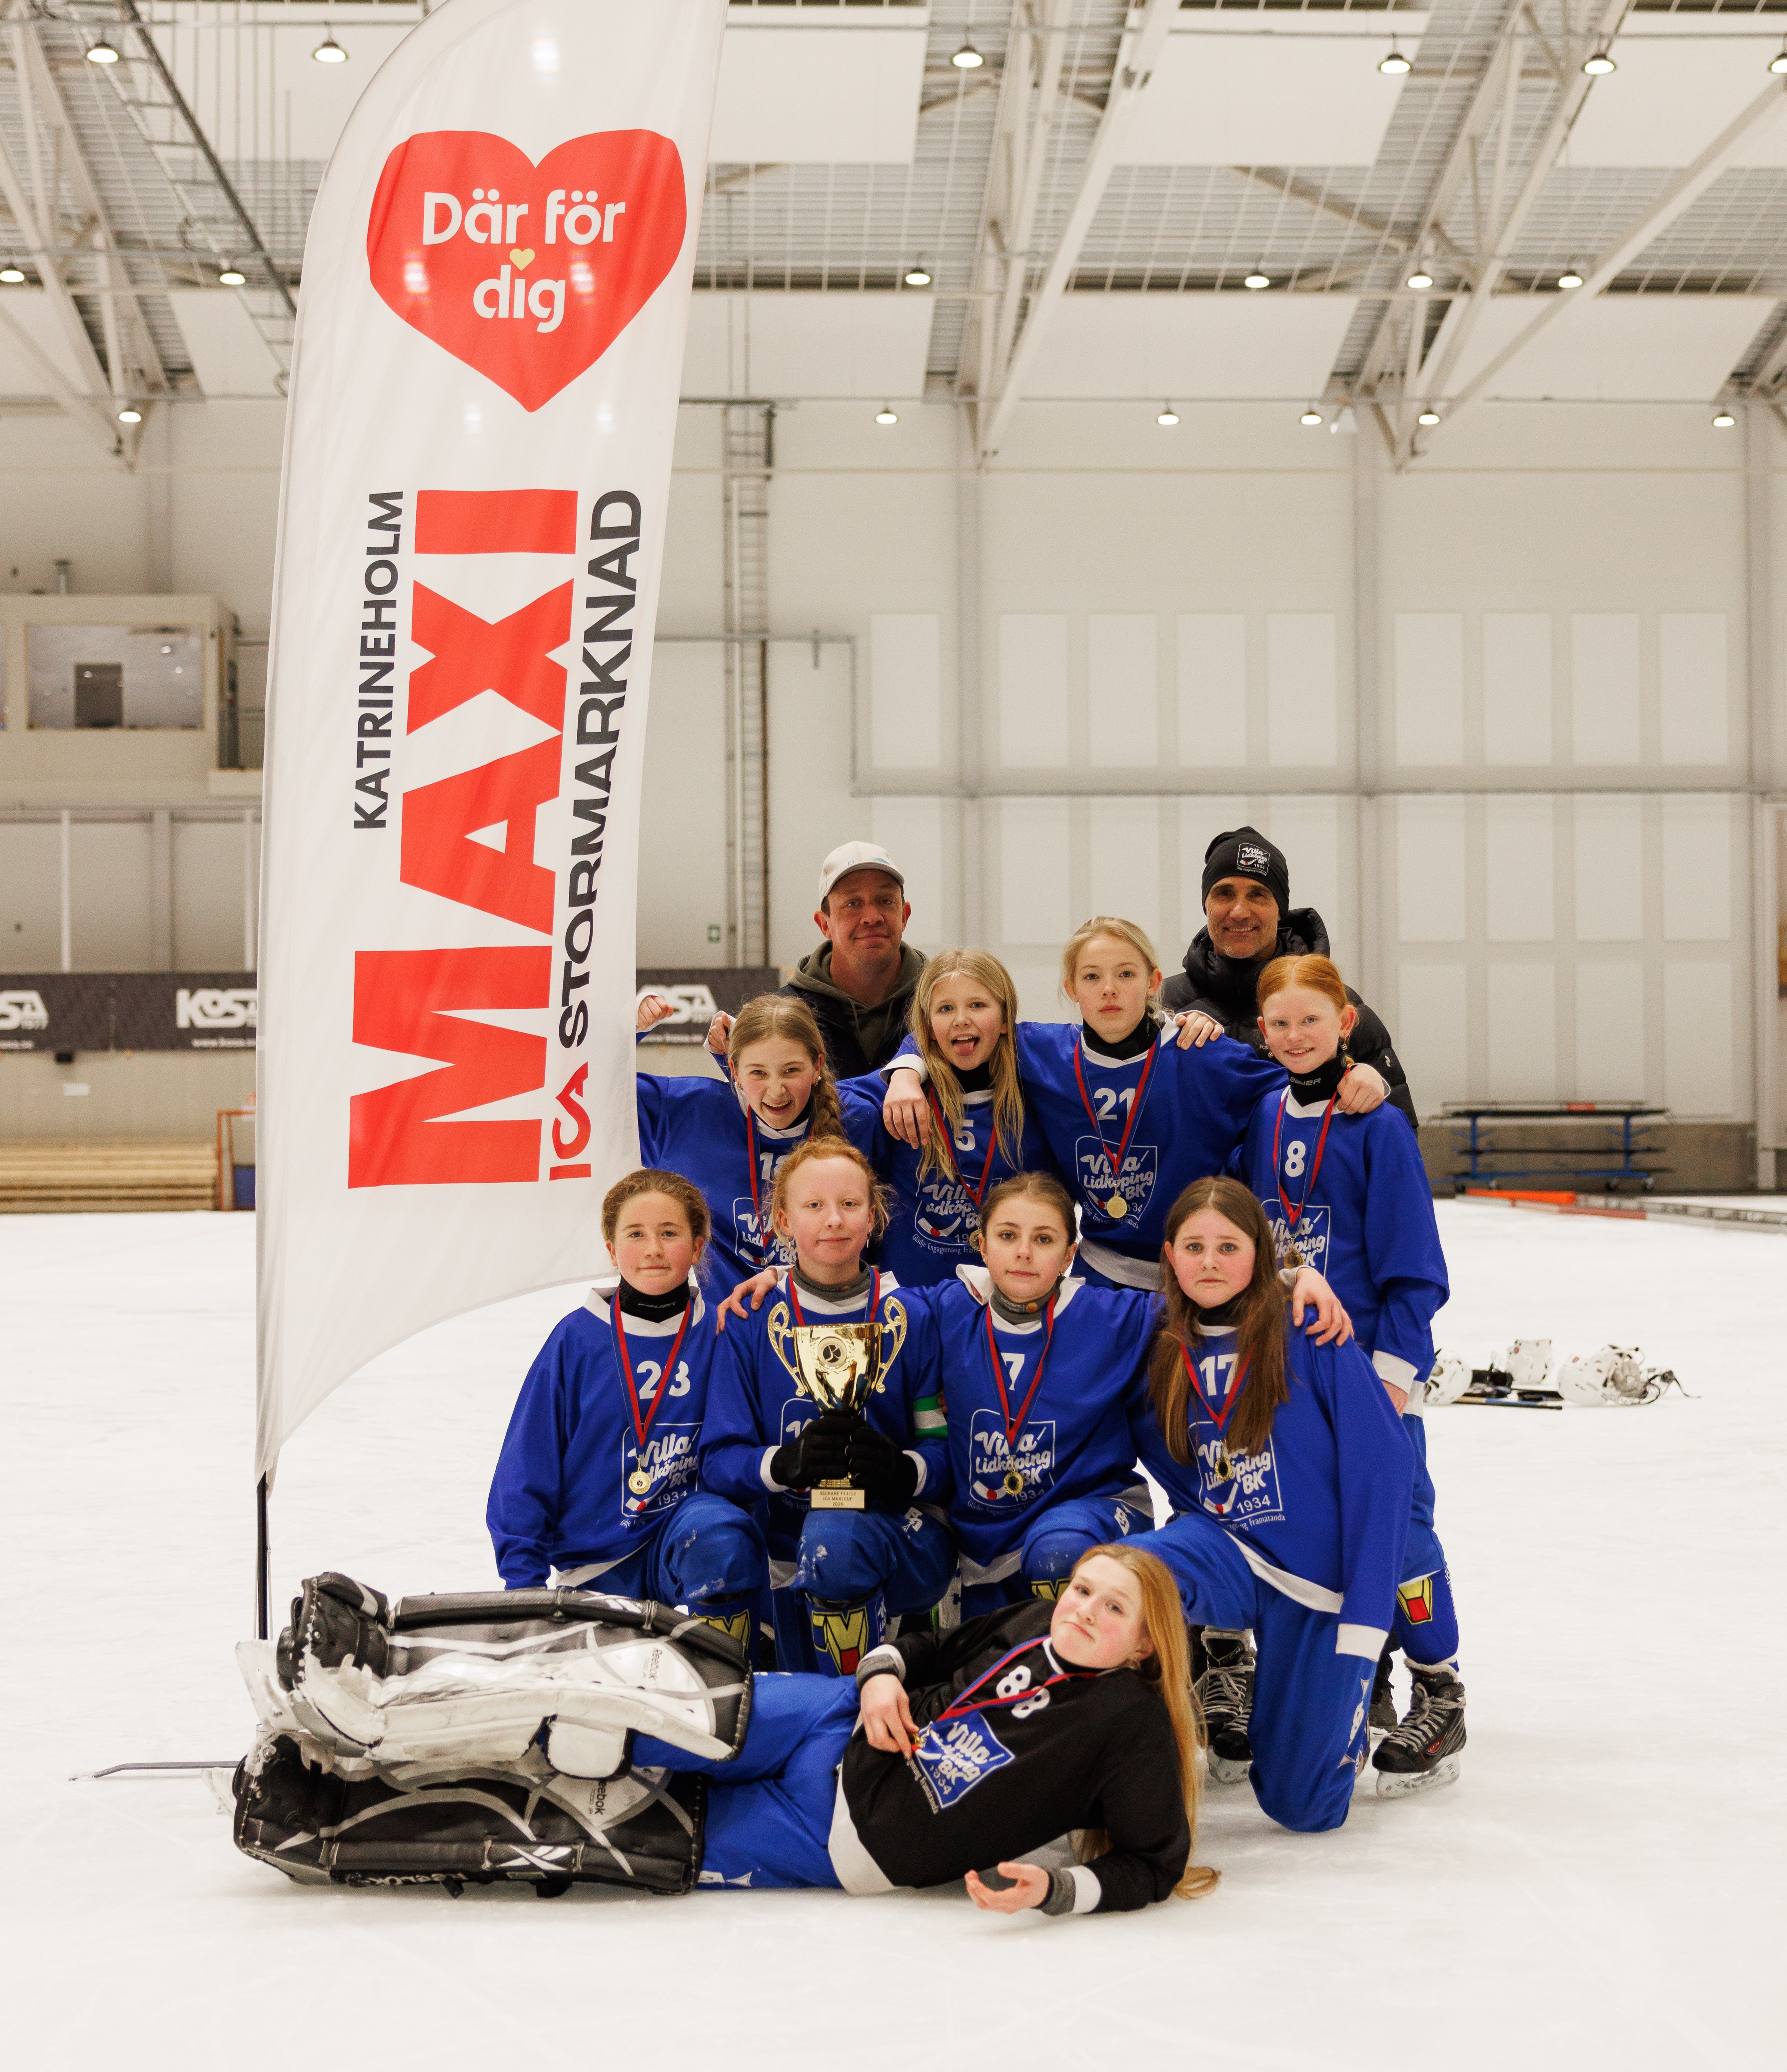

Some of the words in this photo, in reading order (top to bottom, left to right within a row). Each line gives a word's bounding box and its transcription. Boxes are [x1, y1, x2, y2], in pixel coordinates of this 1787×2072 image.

[423, 188, 528, 245] Där
[545, 189, 626, 245] för
[473, 249, 566, 333] dig
[353, 491, 403, 829] KATRINEHOLM
[559, 490, 642, 1048] STORMARKNAD
[348, 489, 578, 1189] MAXI
[549, 1061, 591, 1181] ICA
[1094, 1088, 1136, 1120] 21
[1285, 1141, 1306, 1177] 8
[1125, 1182, 1146, 1200] BK
[912, 1234, 926, 1248] Glädje
[928, 1243, 961, 1255] Engagemang
[954, 1234, 969, 1243] 19
[637, 1360, 691, 1400] 23
[1001, 1353, 1025, 1390] 7
[1200, 1353, 1238, 1396] 17
[669, 1470, 688, 1488] BK
[1242, 1468, 1266, 1495] BK
[656, 1490, 687, 1506] 1934
[1237, 1494, 1271, 1514] 1934
[648, 1648, 662, 1681] Reebok
[996, 1665, 1051, 1719] 88
[595, 1781, 608, 1815] eebok
